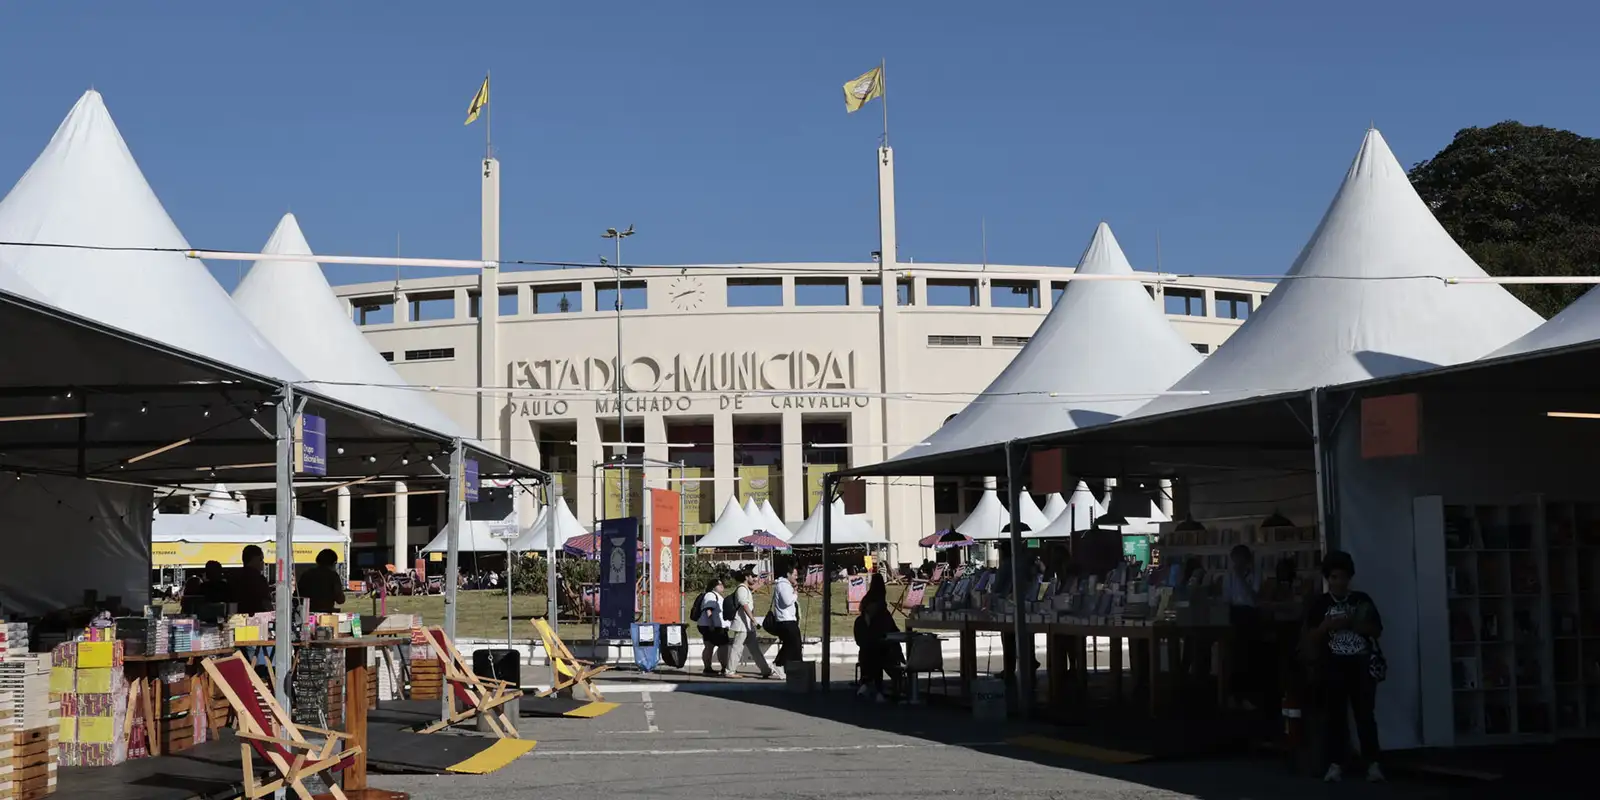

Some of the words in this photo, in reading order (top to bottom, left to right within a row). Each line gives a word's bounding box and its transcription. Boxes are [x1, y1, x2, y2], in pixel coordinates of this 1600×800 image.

[508, 398, 568, 417] PAULO
[595, 396, 692, 414] MACHADO
[719, 394, 744, 411] DE
[771, 395, 870, 409] CARVALHO
